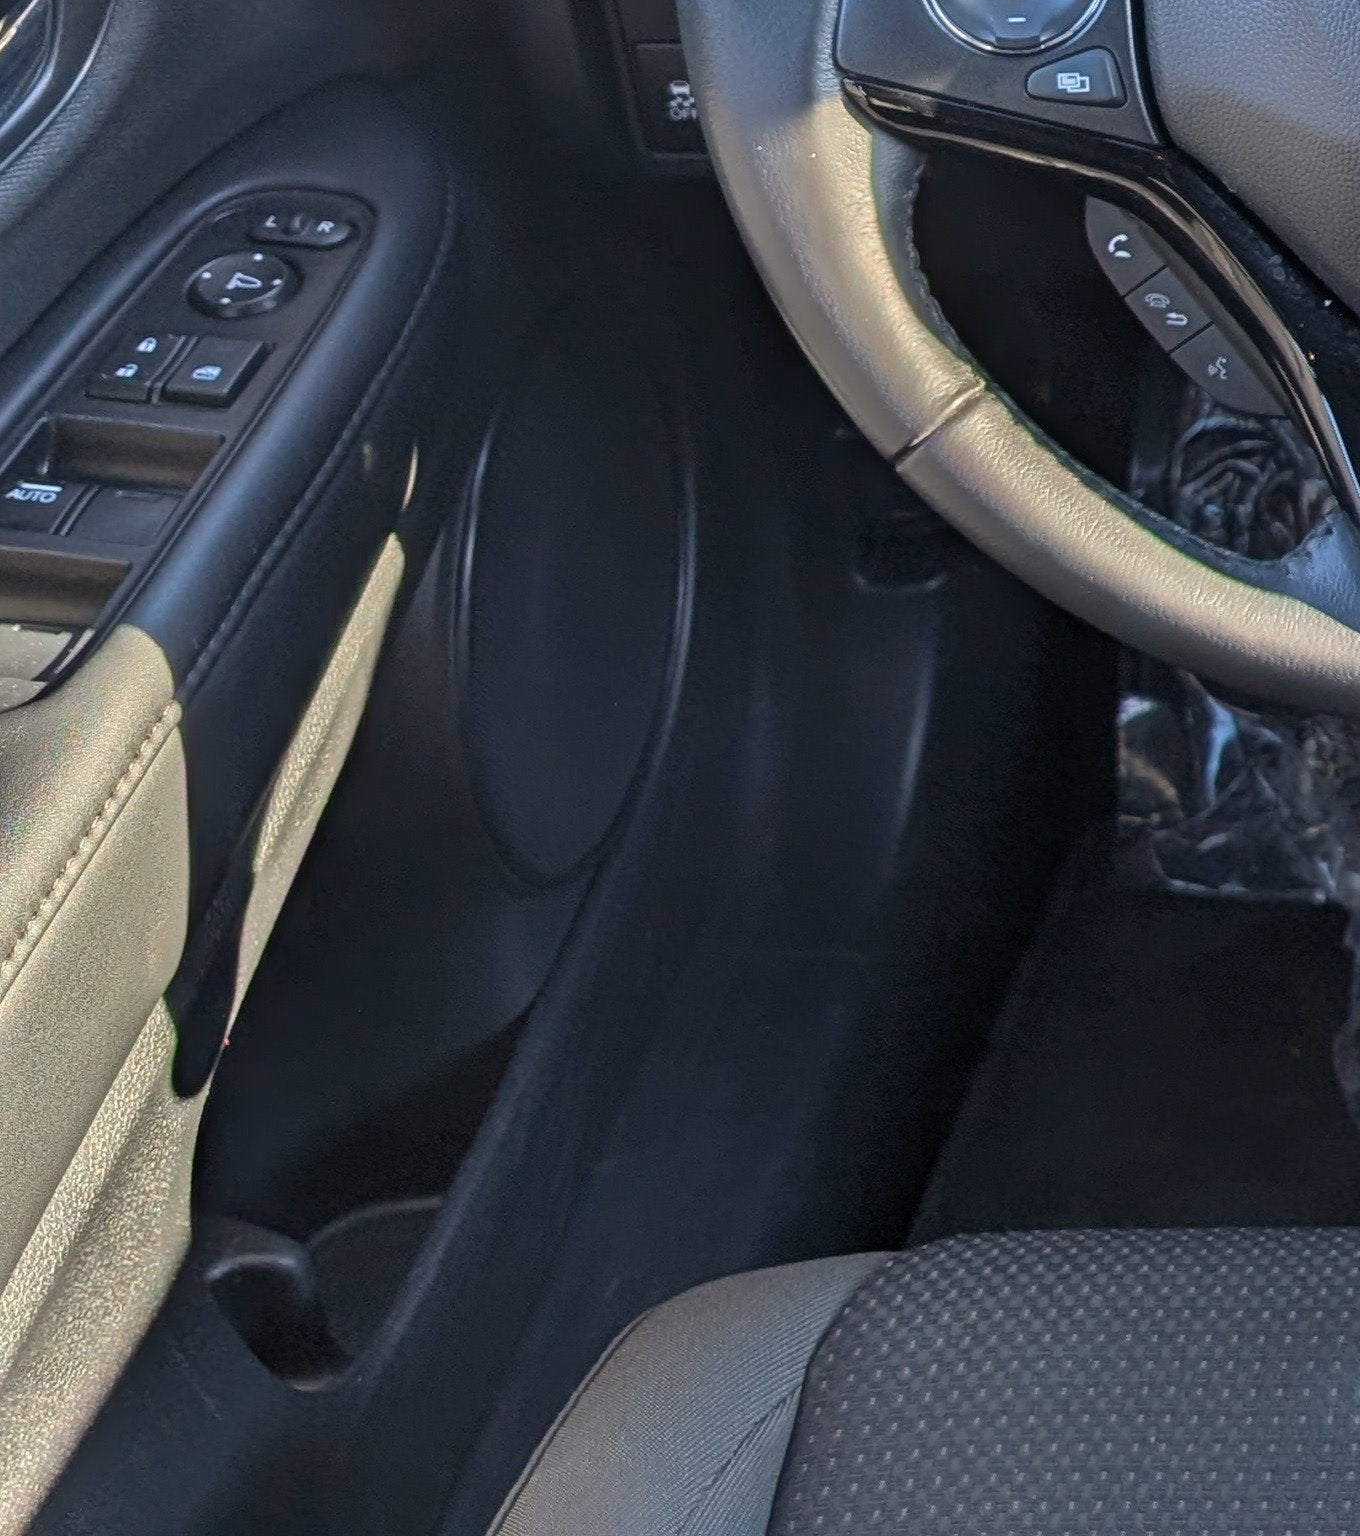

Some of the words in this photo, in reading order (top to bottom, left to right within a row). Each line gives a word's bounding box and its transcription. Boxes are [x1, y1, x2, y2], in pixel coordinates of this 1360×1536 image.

[264, 214, 277, 229] L
[316, 220, 336, 234] R
[5, 489, 57, 504] AUTO
